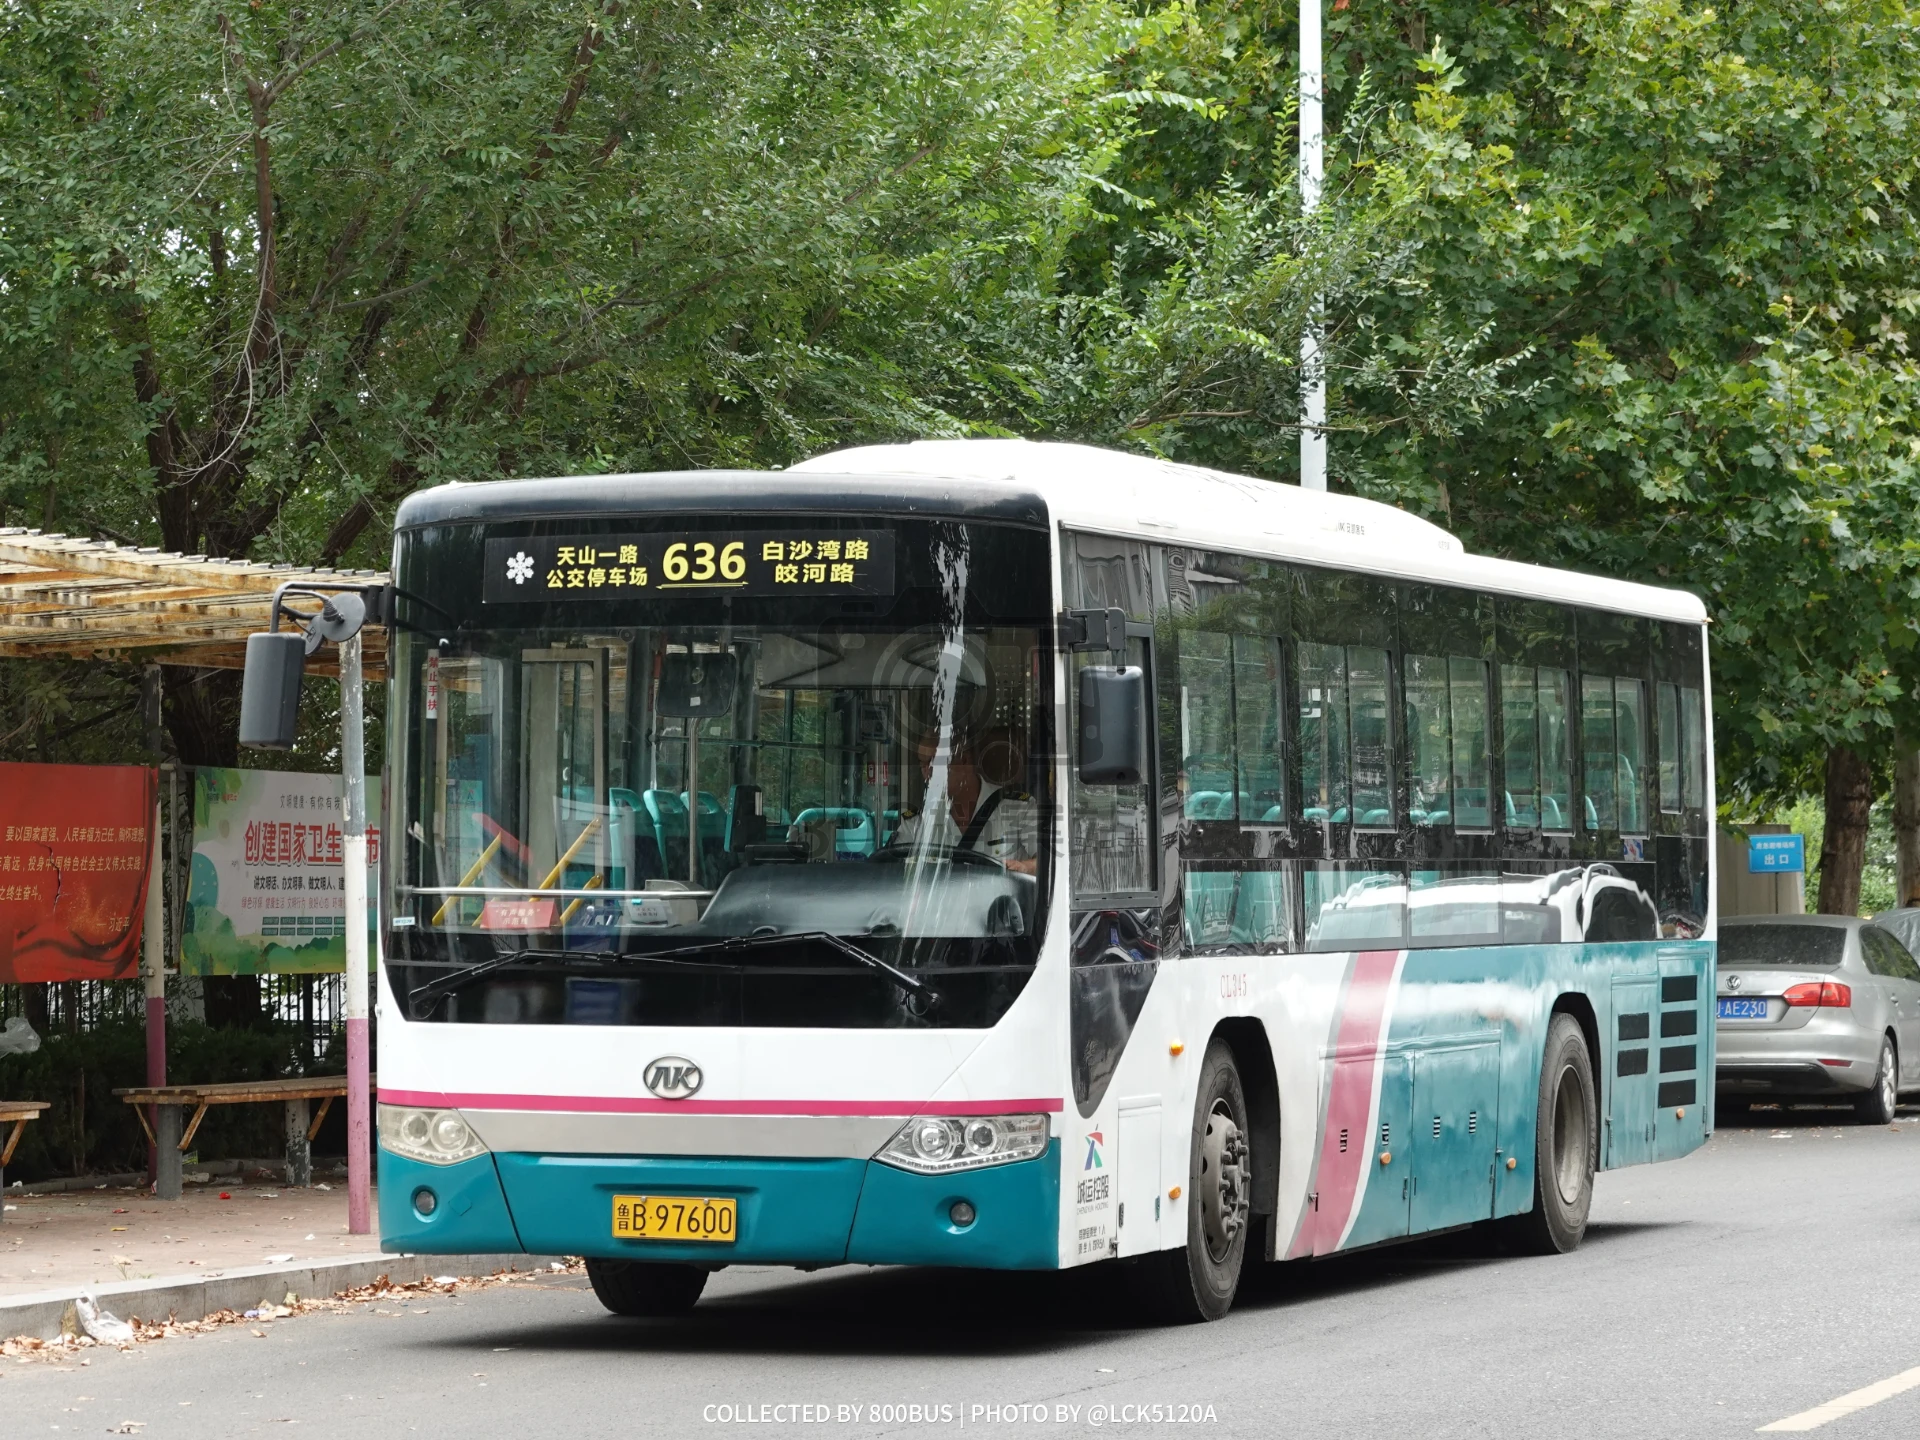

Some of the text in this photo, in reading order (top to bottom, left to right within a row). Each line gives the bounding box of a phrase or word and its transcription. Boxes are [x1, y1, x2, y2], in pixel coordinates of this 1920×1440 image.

[556, 545, 639, 566] 天山一路
[762, 539, 869, 561] 白沙湾路
[661, 542, 747, 582] 636
[546, 566, 648, 589] 公交停车场
[774, 563, 855, 584] 皎河路
[427, 656, 438, 711] 禁止手扶
[243, 819, 381, 867] 创建国家卫生市
[1764, 853, 1790, 866] 出口
